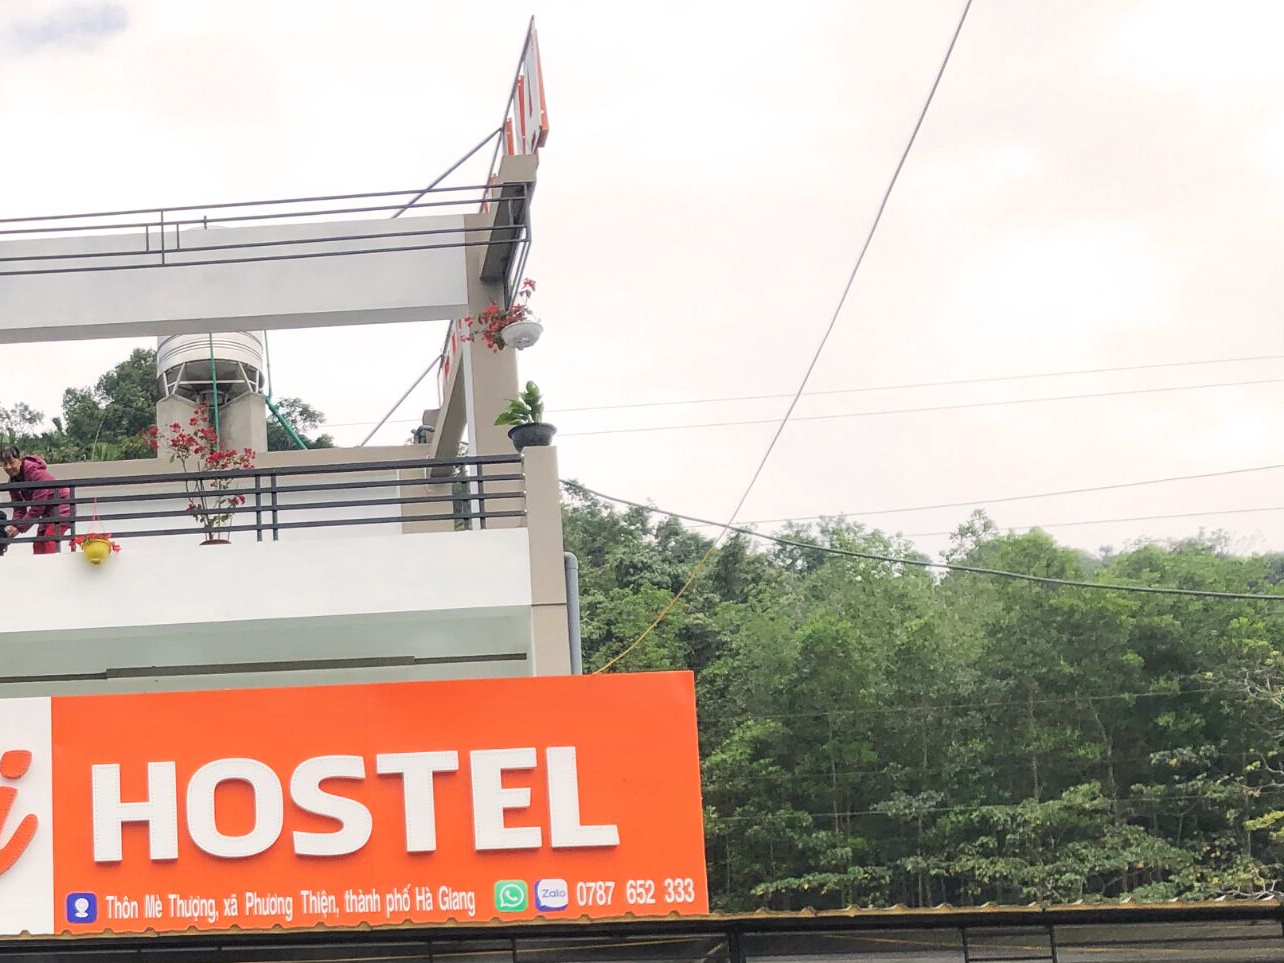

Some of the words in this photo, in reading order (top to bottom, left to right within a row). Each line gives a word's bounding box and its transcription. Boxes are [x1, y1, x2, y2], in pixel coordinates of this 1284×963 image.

[91, 745, 621, 863] HOSTEL
[106, 895, 139, 919] Thôn
[145, 894, 163, 918] Mè
[224, 894, 238, 917] xã
[245, 892, 293, 922] Phương
[345, 889, 381, 913] thành
[385, 883, 412, 918] phố
[416, 887, 433, 911] Hà
[438, 885, 476, 917] Giang
[541, 889, 566, 899] Zalo
[576, 881, 615, 906] 0787
[626, 879, 656, 904] 652
[664, 878, 695, 903] 333
